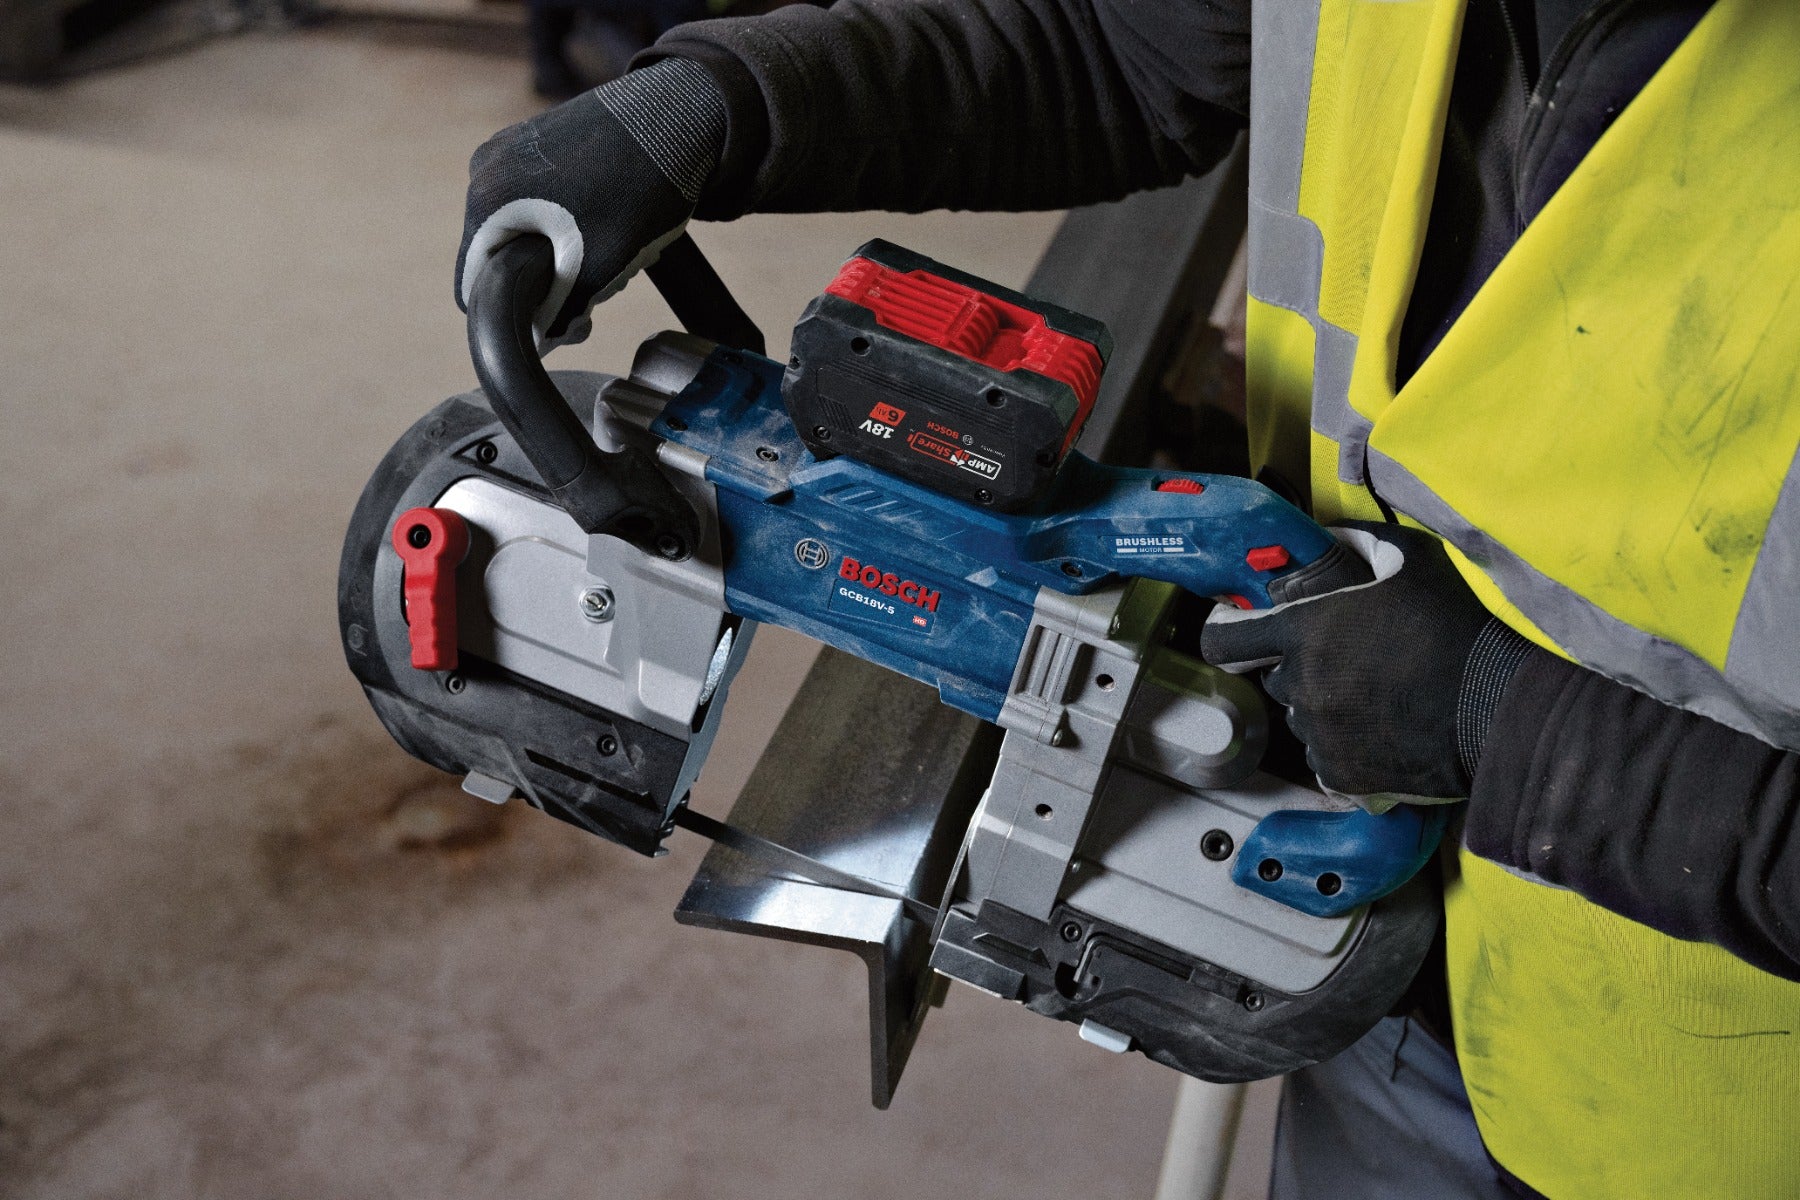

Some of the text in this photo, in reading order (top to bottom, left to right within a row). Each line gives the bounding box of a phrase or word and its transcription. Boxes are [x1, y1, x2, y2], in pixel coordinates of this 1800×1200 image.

[887, 410, 900, 422] 6
[858, 419, 895, 439] 18V
[927, 421, 960, 440] BOSCH
[917, 437, 997, 474] AMP Share
[1115, 537, 1184, 546] BRUSHLESS
[839, 556, 941, 612] BOSCH
[839, 587, 896, 615] GCB18V-5
